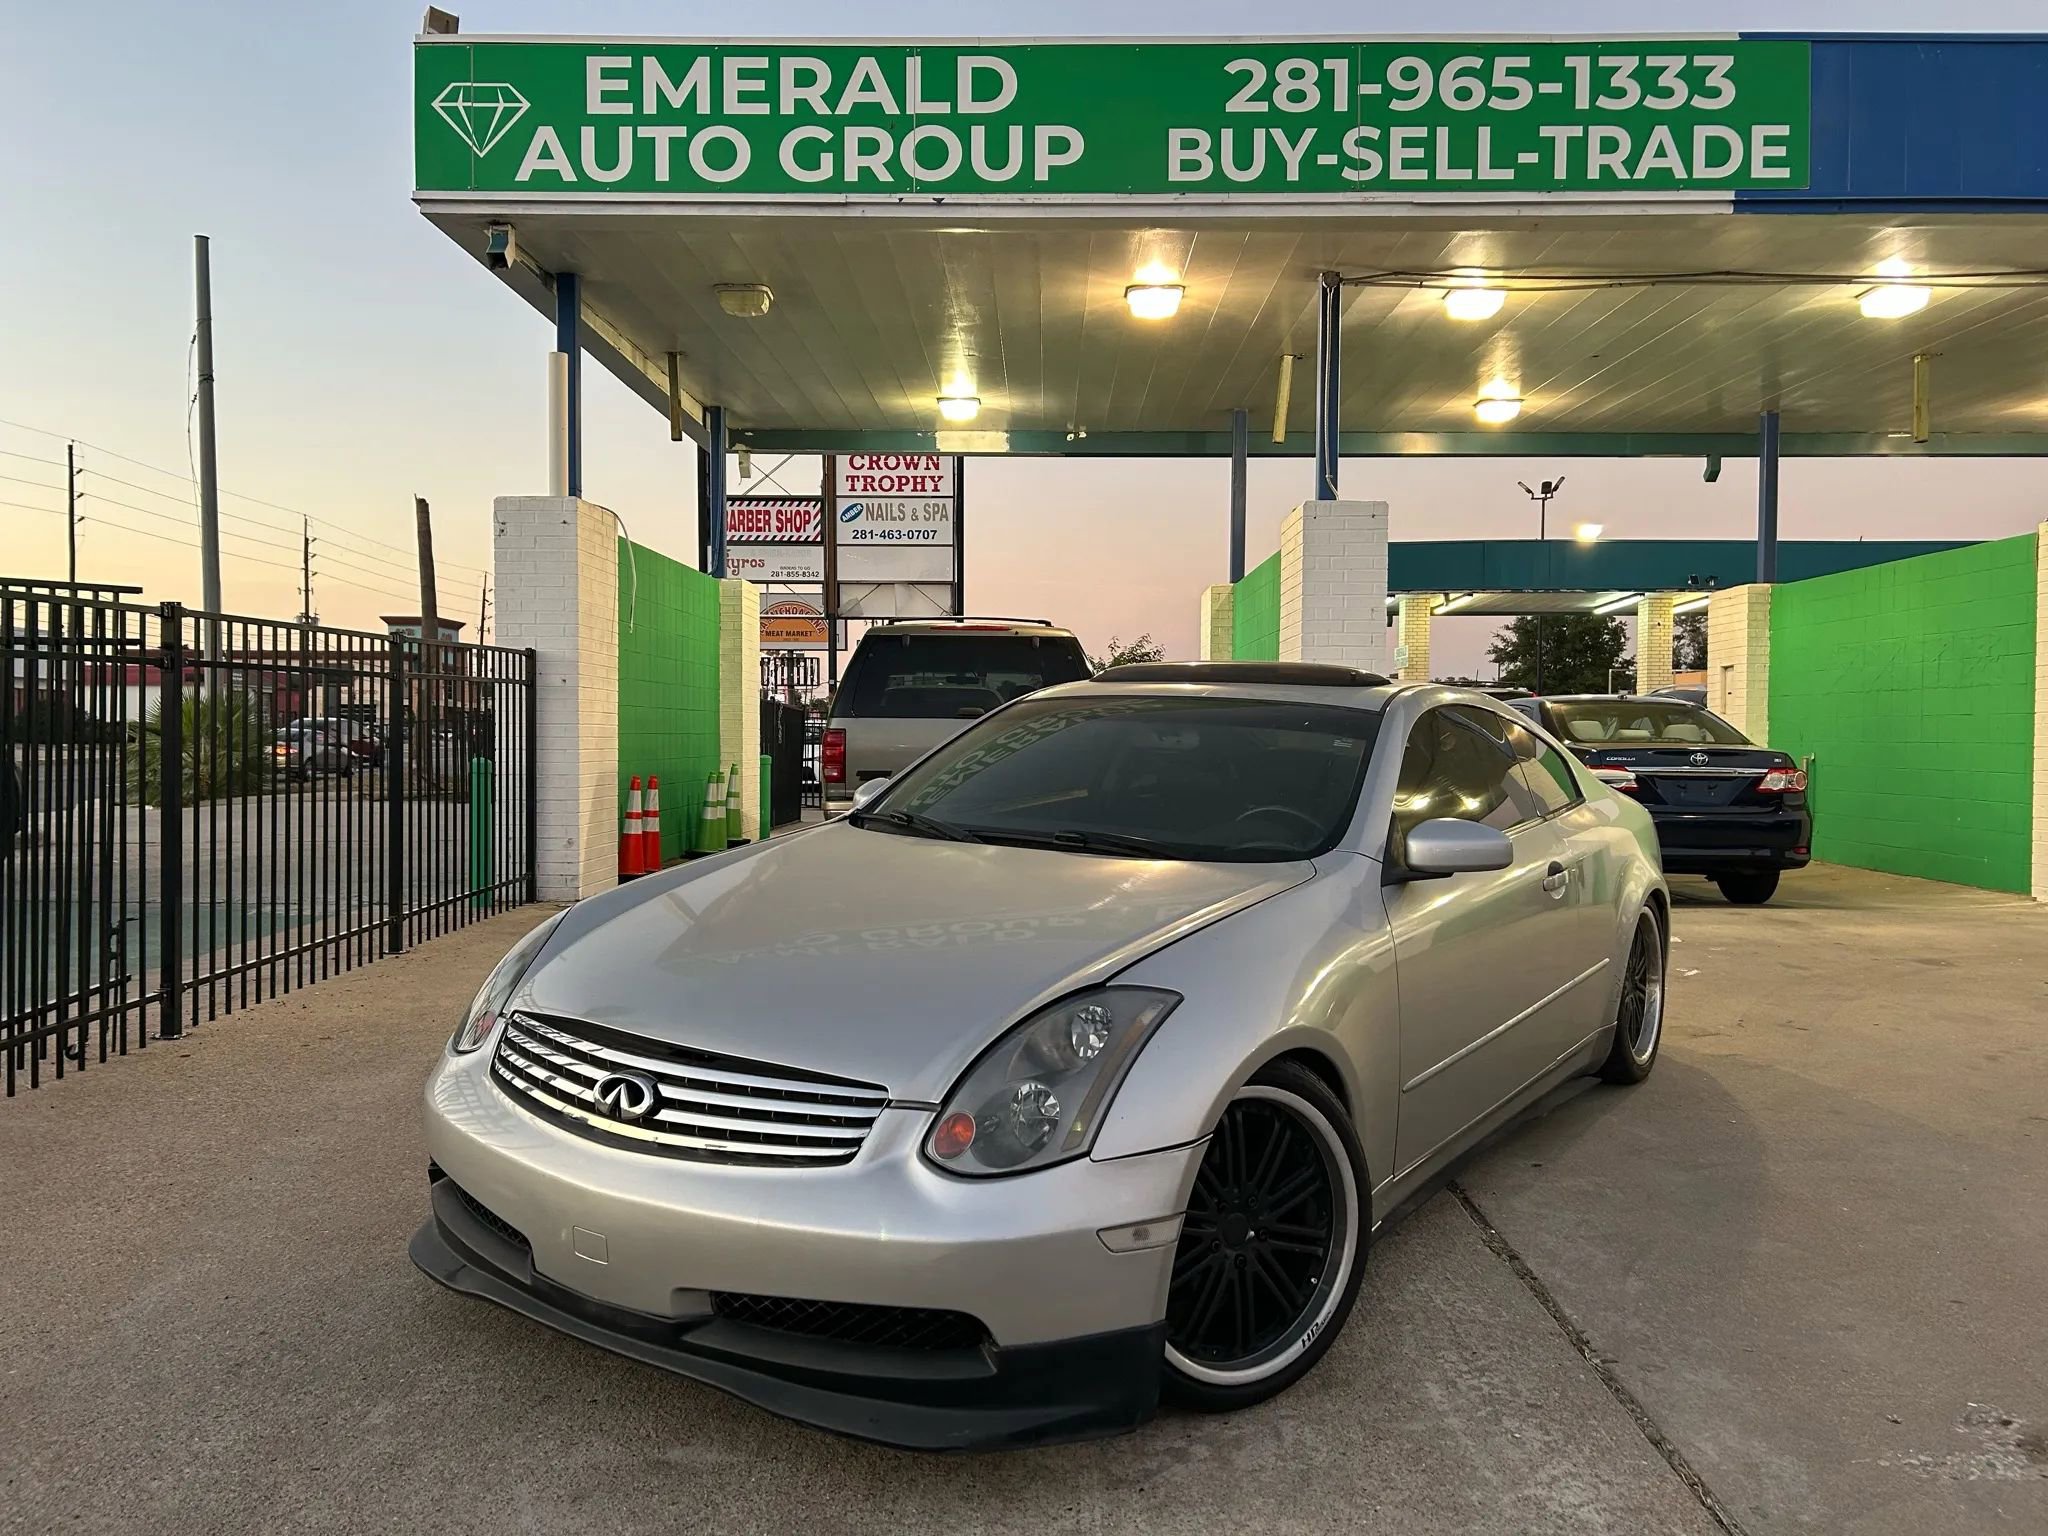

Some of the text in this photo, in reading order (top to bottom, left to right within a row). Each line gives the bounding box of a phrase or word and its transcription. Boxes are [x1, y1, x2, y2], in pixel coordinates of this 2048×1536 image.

[586, 55, 1018, 115] EMERALD
[1223, 54, 1737, 113] 281-965-1333
[514, 124, 1085, 182] AUTO GROUP
[1167, 124, 1791, 182] BUY-SELL-TRADE
[848, 455, 940, 471] CROWN
[846, 475, 944, 492] TROPHY
[775, 509, 811, 533] SHOP
[841, 503, 862, 522] AMBER
[865, 503, 949, 522] NAILS & SPA
[852, 529, 938, 540] 281-463-0707
[771, 570, 820, 578] 281-855-8342
